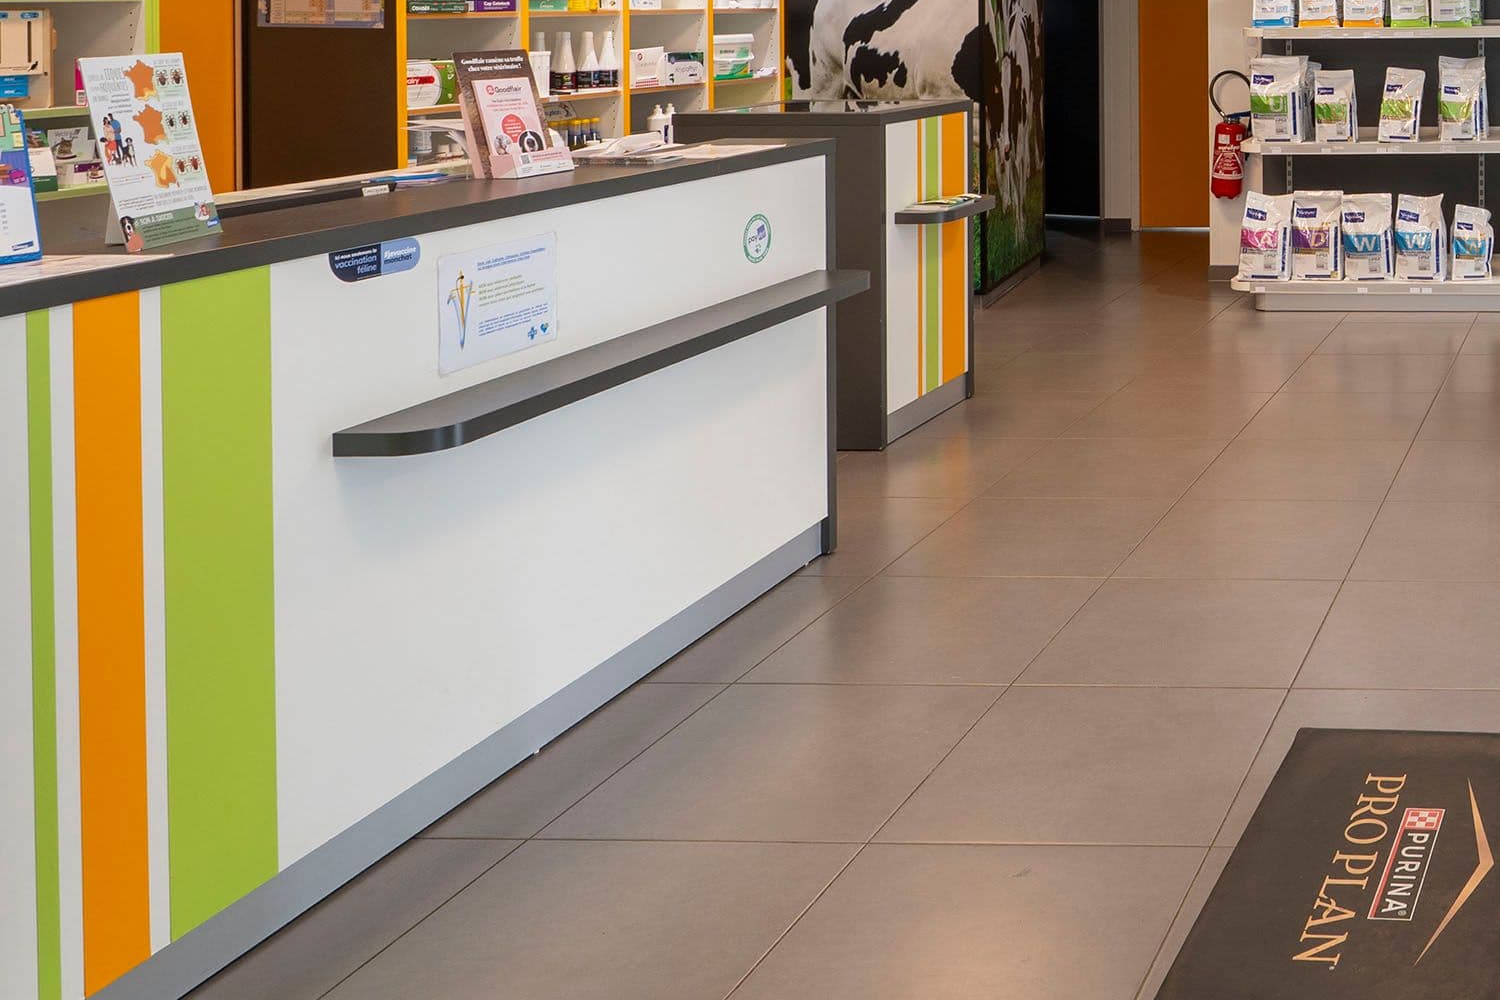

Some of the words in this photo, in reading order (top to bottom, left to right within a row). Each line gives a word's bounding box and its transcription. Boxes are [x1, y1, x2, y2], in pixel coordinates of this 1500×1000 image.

[494, 85, 522, 94] Goodflair
[1353, 236, 1377, 252] W
[1405, 233, 1427, 249] W
[334, 255, 377, 269] vaccination
[357, 264, 377, 274] féline
[1343, 772, 1408, 846] PRO
[1381, 831, 1429, 914] PURINA
[1291, 849, 1380, 971] PLAN
